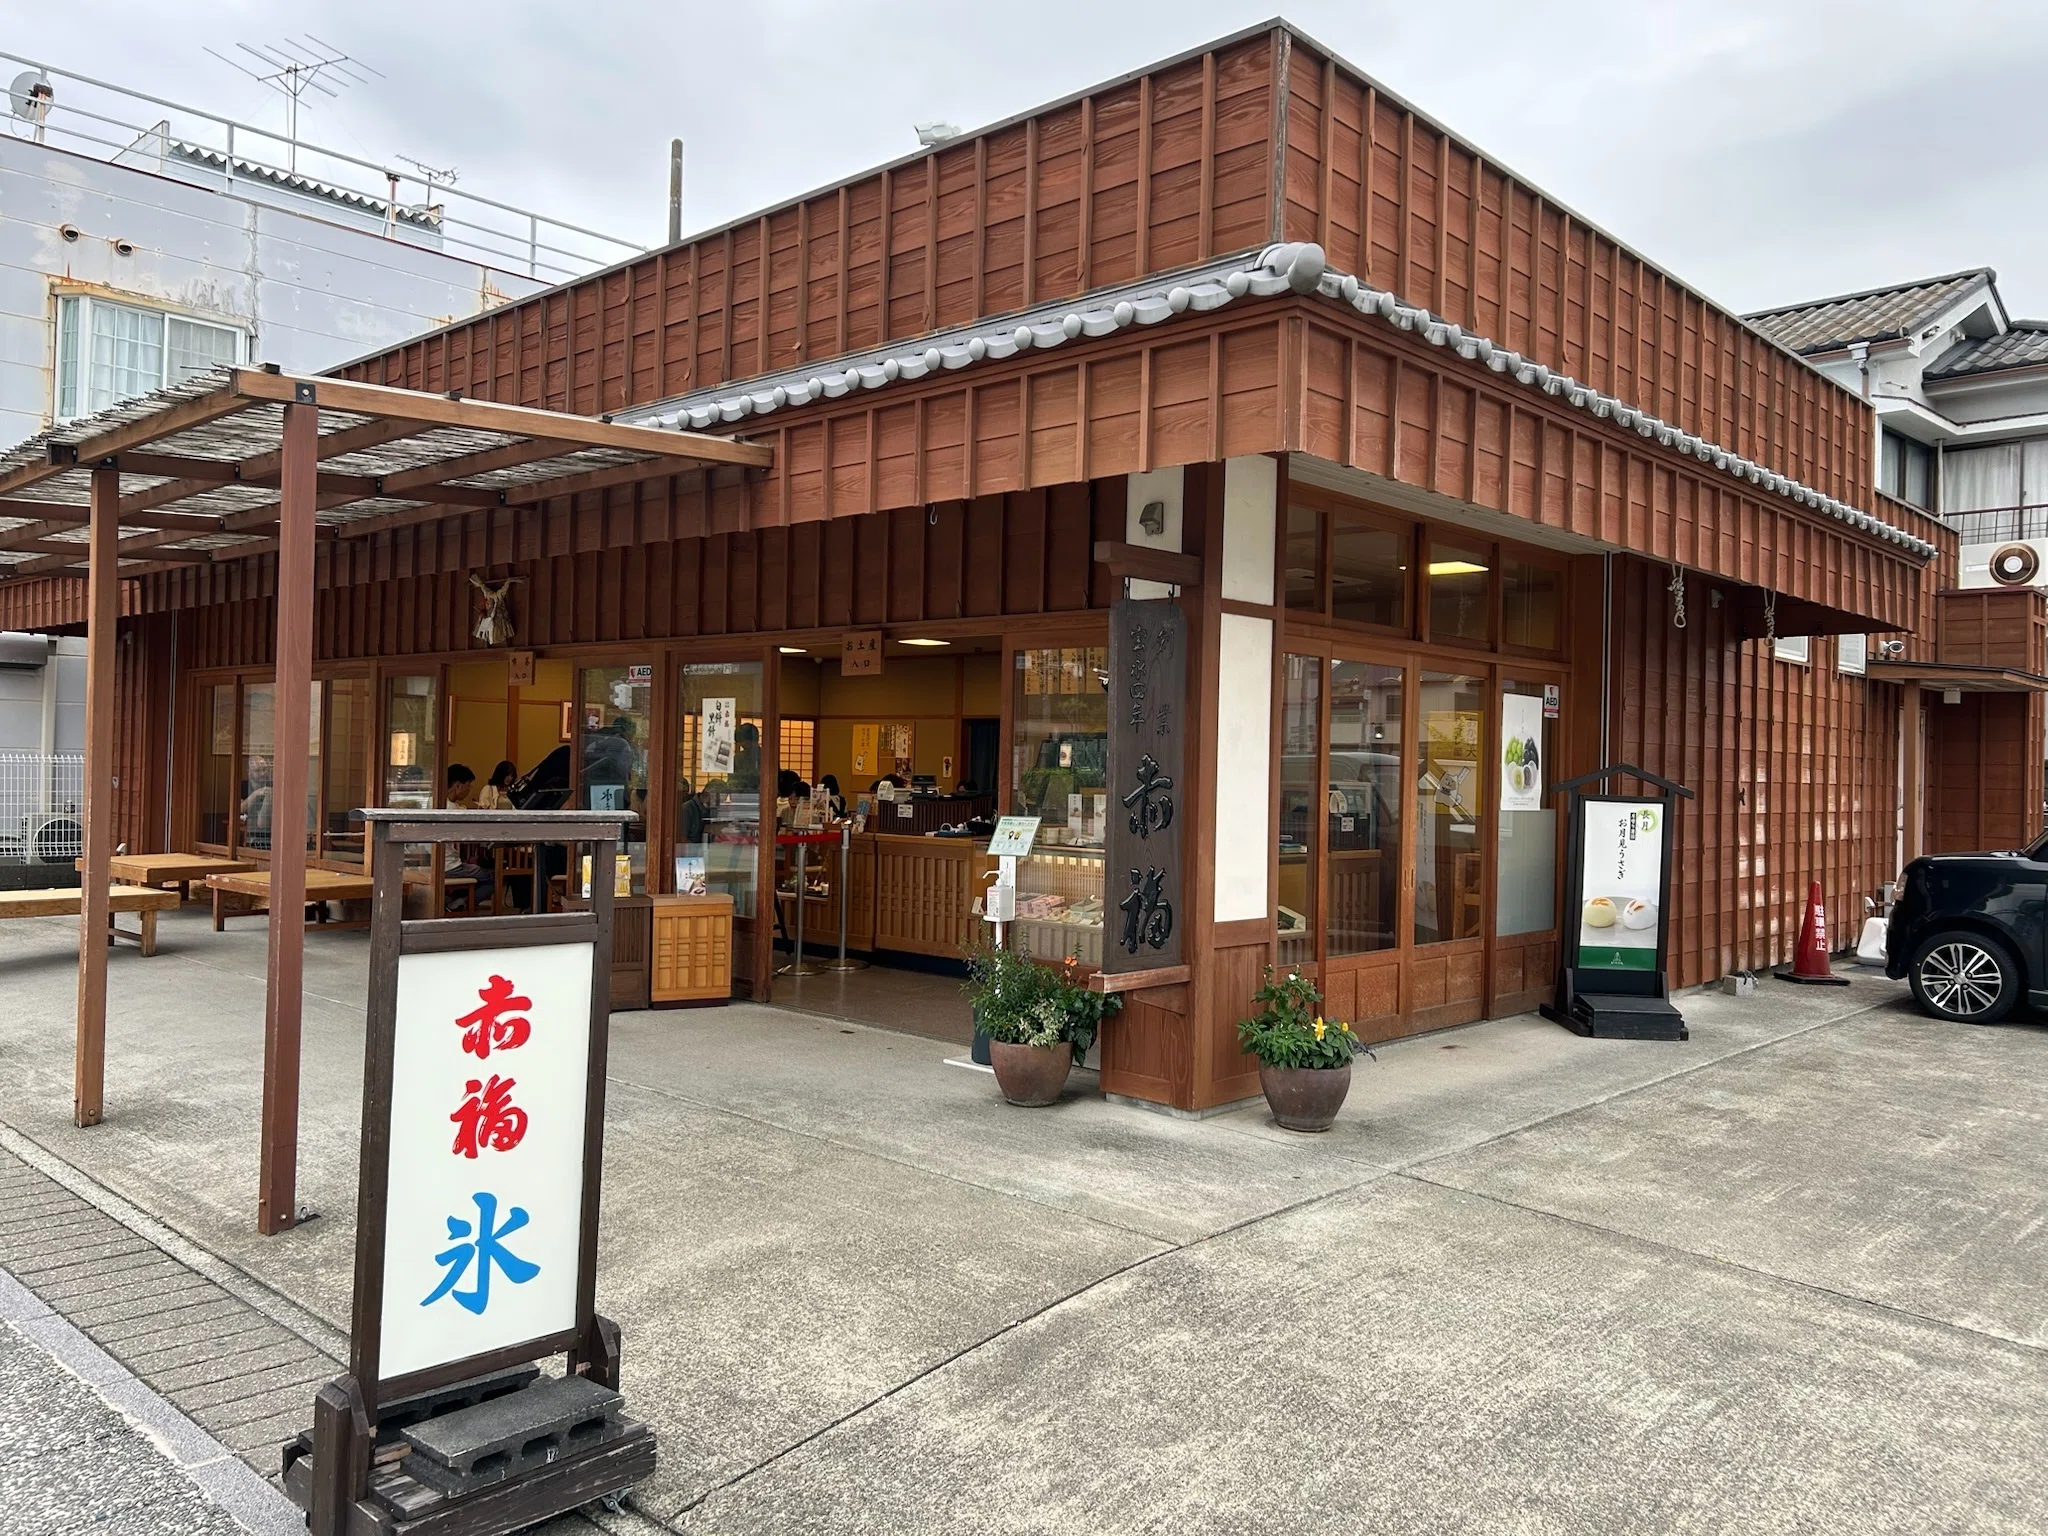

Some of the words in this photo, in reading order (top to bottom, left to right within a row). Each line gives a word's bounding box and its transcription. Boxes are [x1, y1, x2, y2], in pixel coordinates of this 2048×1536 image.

[846, 638, 876, 651] お土産
[637, 667, 651, 676] AED
[853, 658, 870, 668] 入口
[1546, 697, 1557, 706] AED
[1640, 809, 1650, 831] 長月
[1119, 753, 1174, 953] 赤福
[1617, 818, 1628, 880] お月見うさぎ
[1814, 904, 1826, 951] 駐車禁止
